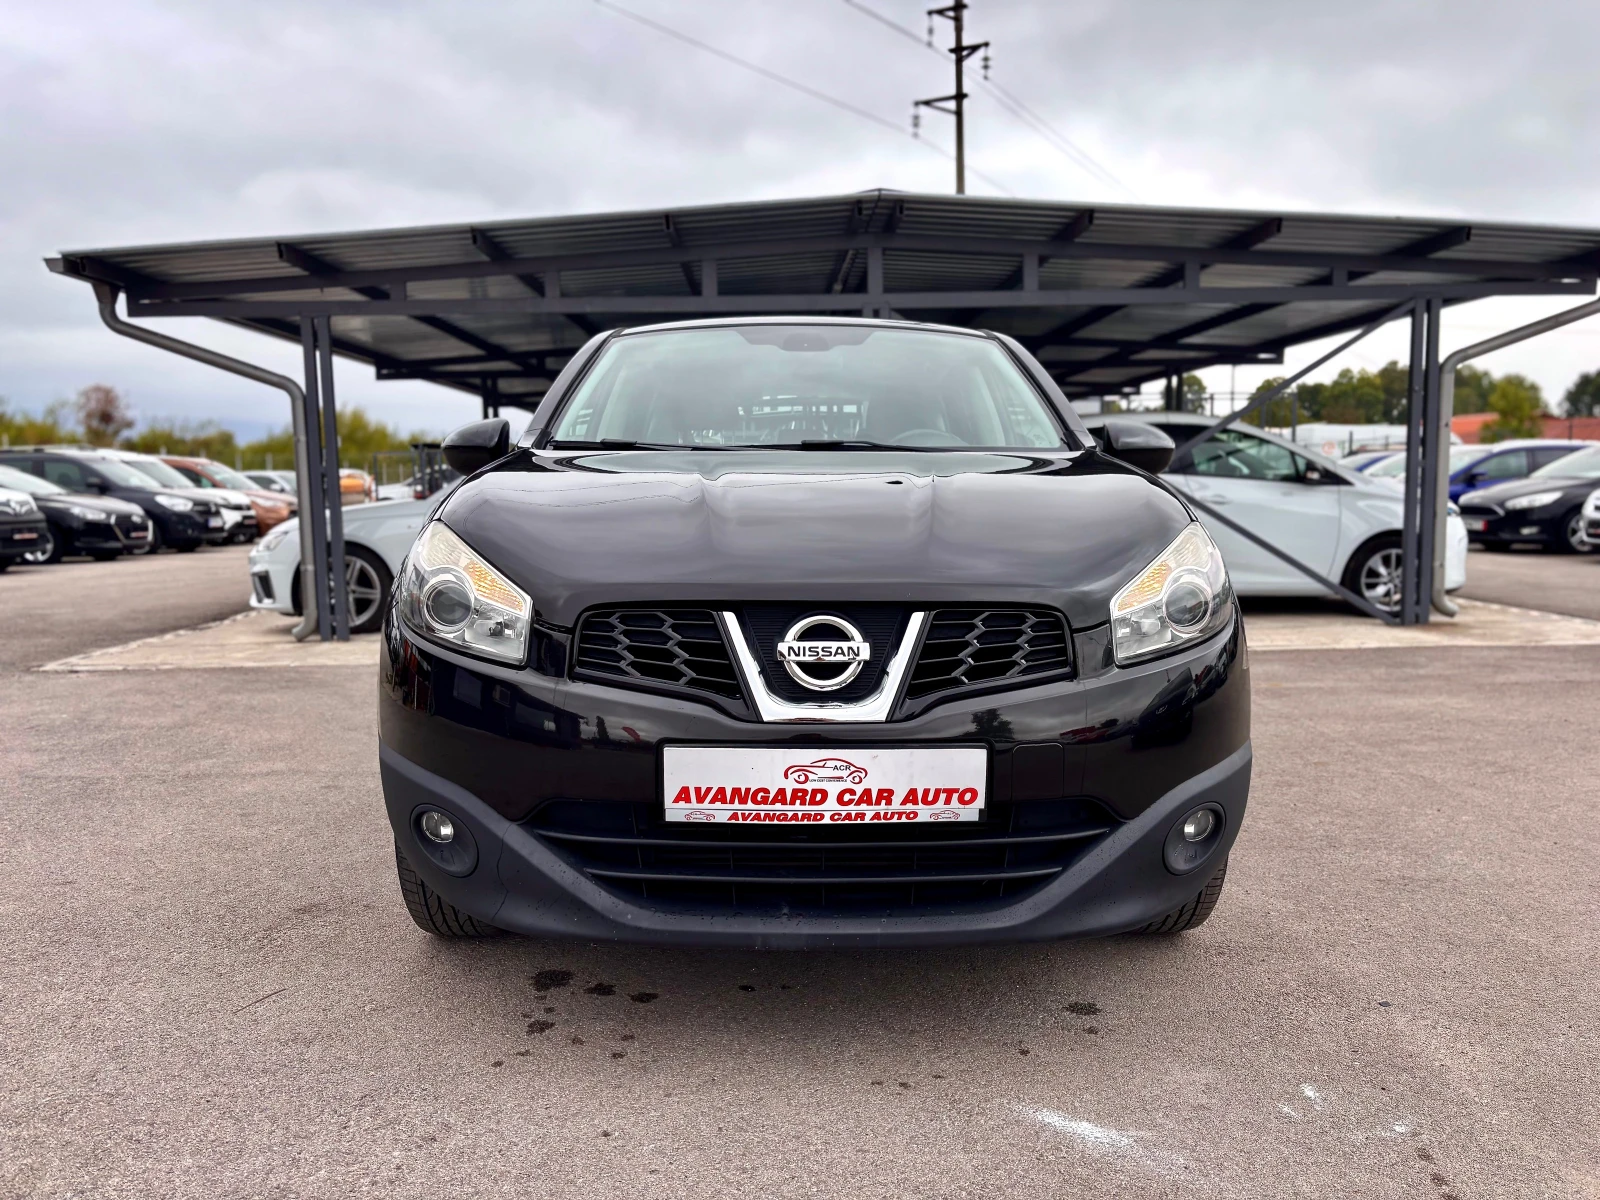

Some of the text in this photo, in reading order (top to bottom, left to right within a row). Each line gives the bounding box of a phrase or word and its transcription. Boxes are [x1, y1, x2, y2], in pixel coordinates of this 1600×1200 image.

[787, 646, 860, 657] NISSAN
[672, 786, 978, 807] AVANGARD CAR AUTO
[727, 810, 918, 822] AVANGARD CAR AUTO
